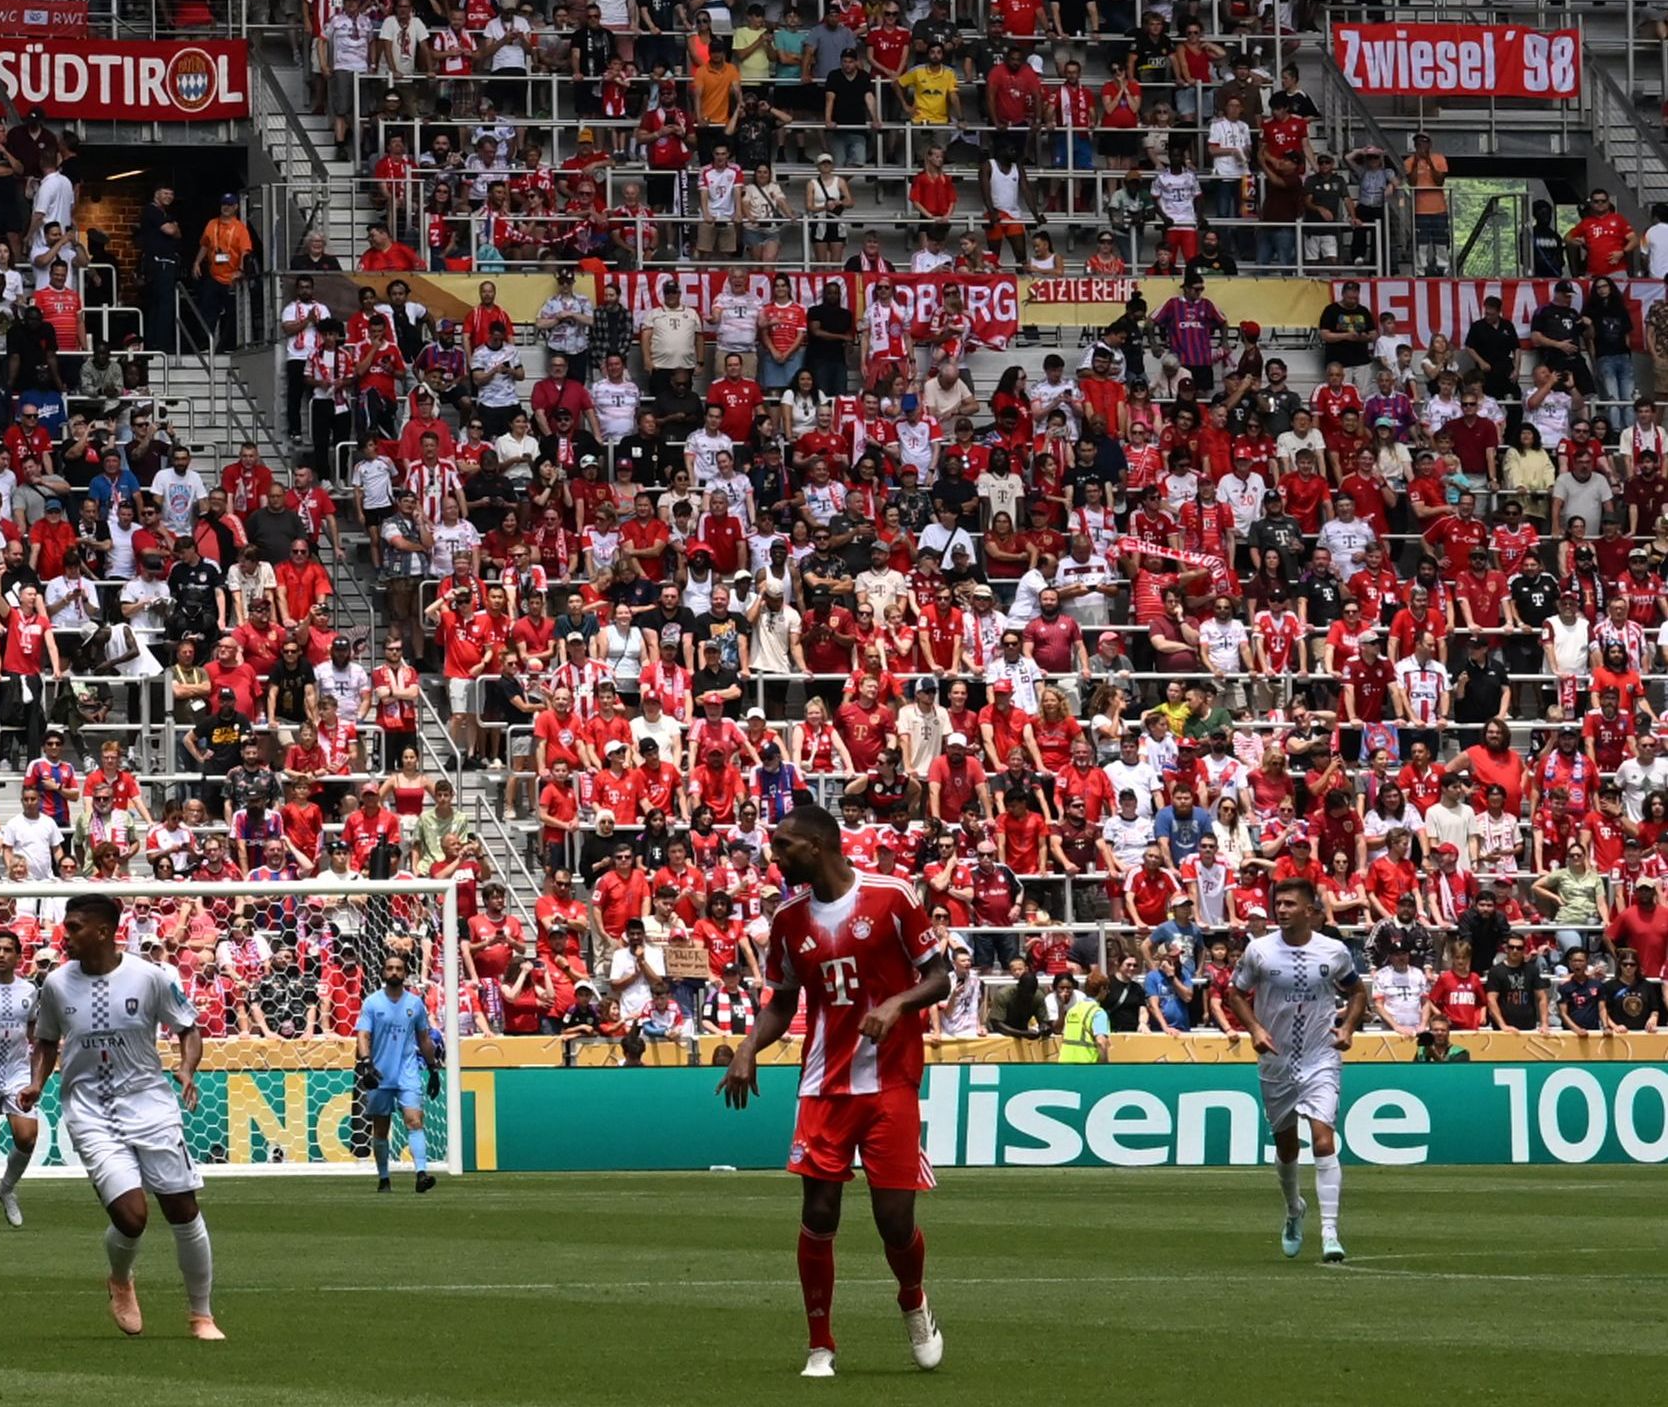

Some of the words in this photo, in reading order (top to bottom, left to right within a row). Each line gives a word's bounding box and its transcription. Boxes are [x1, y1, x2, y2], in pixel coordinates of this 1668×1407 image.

[1339, 29, 1496, 90] Zwiesel
[1239, 494, 1256, 508] 20
[819, 956, 859, 1007] T
[1284, 993, 1318, 1003] ULTRA
[80, 1036, 127, 1049] ULTRA
[460, 1071, 498, 1171] 1
